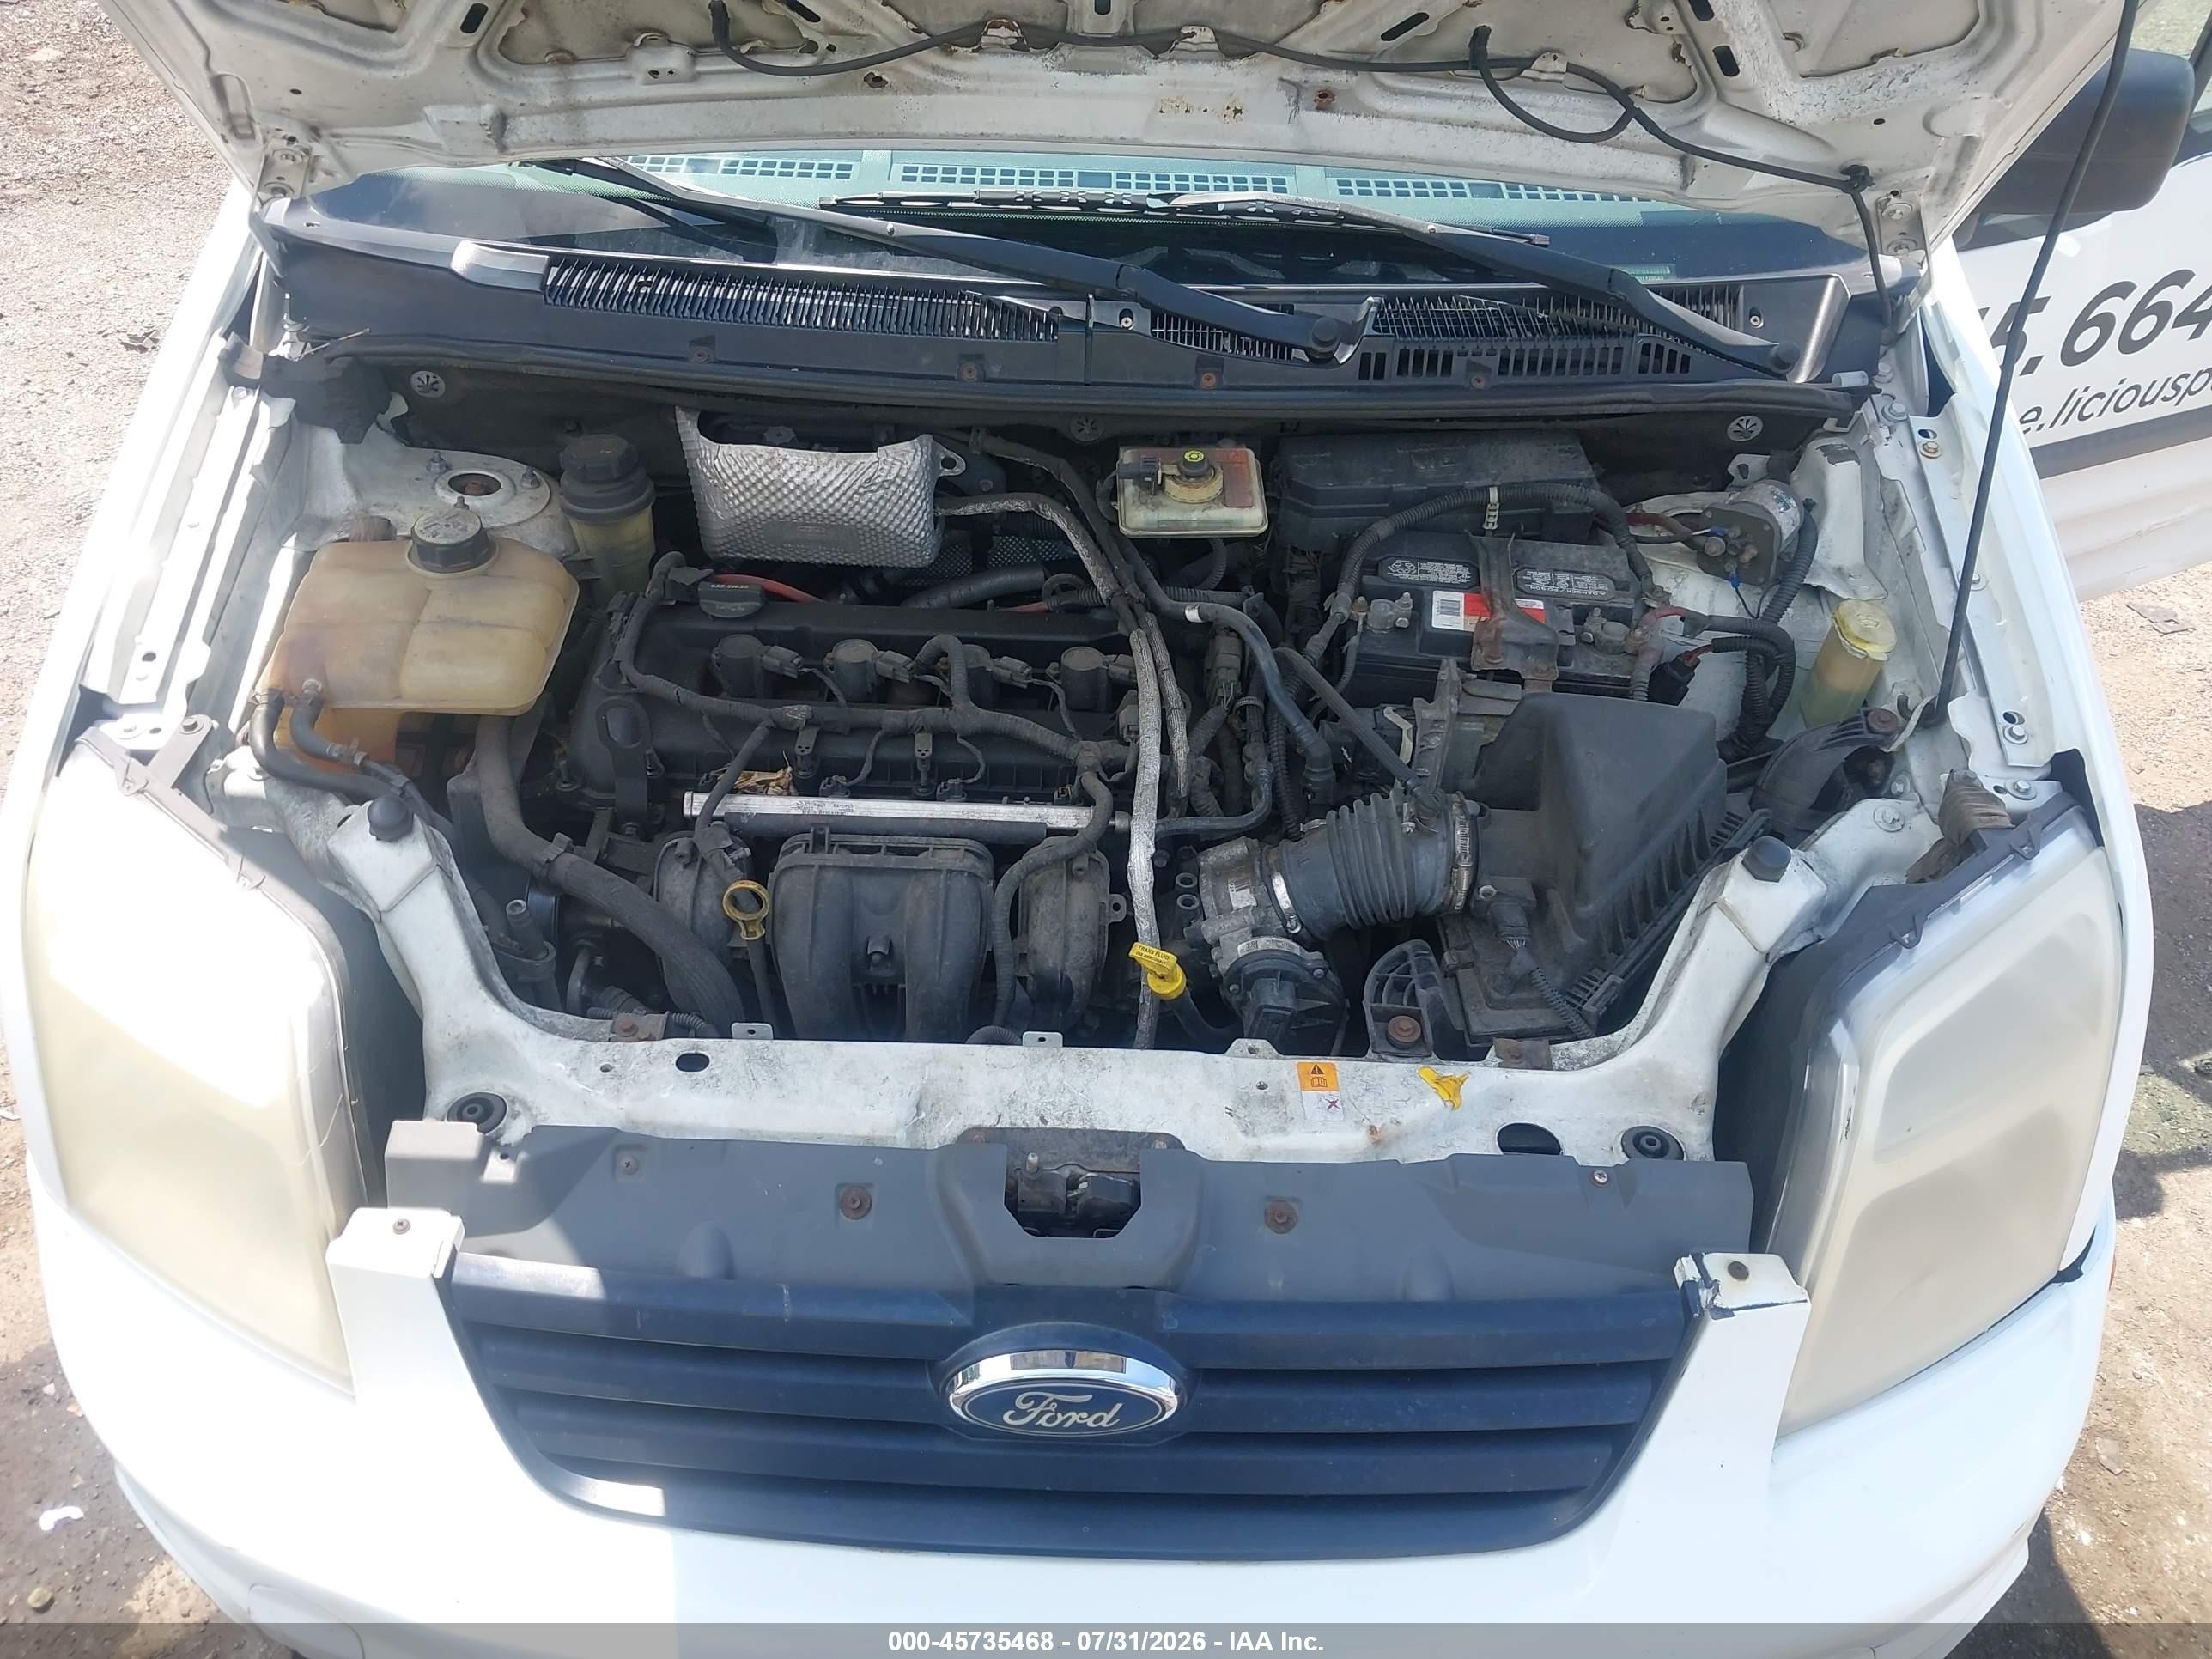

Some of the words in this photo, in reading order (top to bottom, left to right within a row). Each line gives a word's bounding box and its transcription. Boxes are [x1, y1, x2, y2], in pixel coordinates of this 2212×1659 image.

[1978, 269, 2212, 376] 5.664
[2020, 367, 2212, 434] e.liciousp
[1002, 1391, 1123, 1428] Ford
